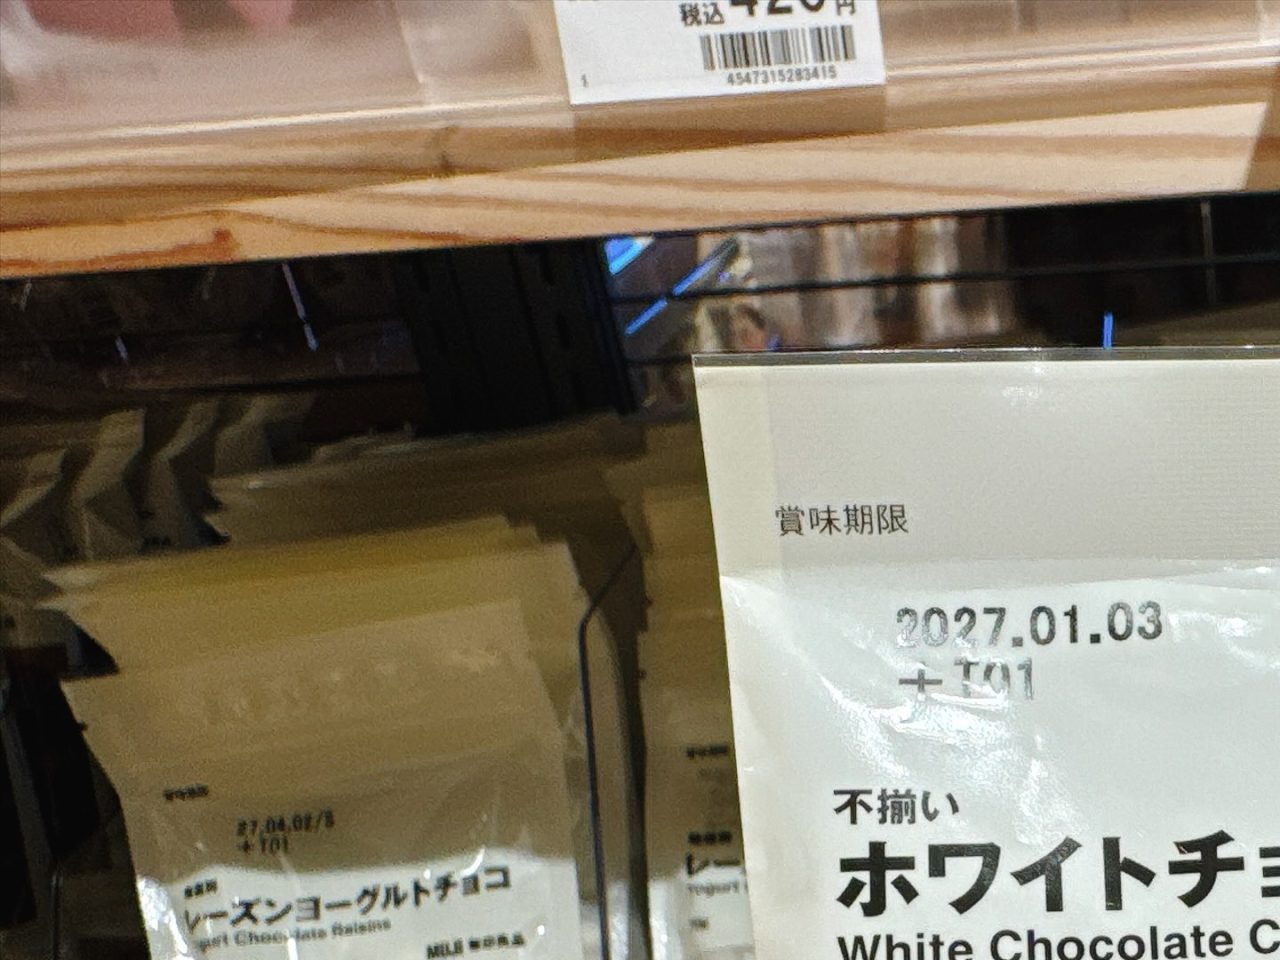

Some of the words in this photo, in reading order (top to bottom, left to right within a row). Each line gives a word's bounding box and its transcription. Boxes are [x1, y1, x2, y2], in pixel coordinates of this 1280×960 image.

[775, 504, 909, 537] 賞味期限
[896, 601, 1164, 648] 2027.01.03
[833, 788, 960, 825] 不揃い
[184, 865, 512, 934] レーズンヨーグルトチョコ
